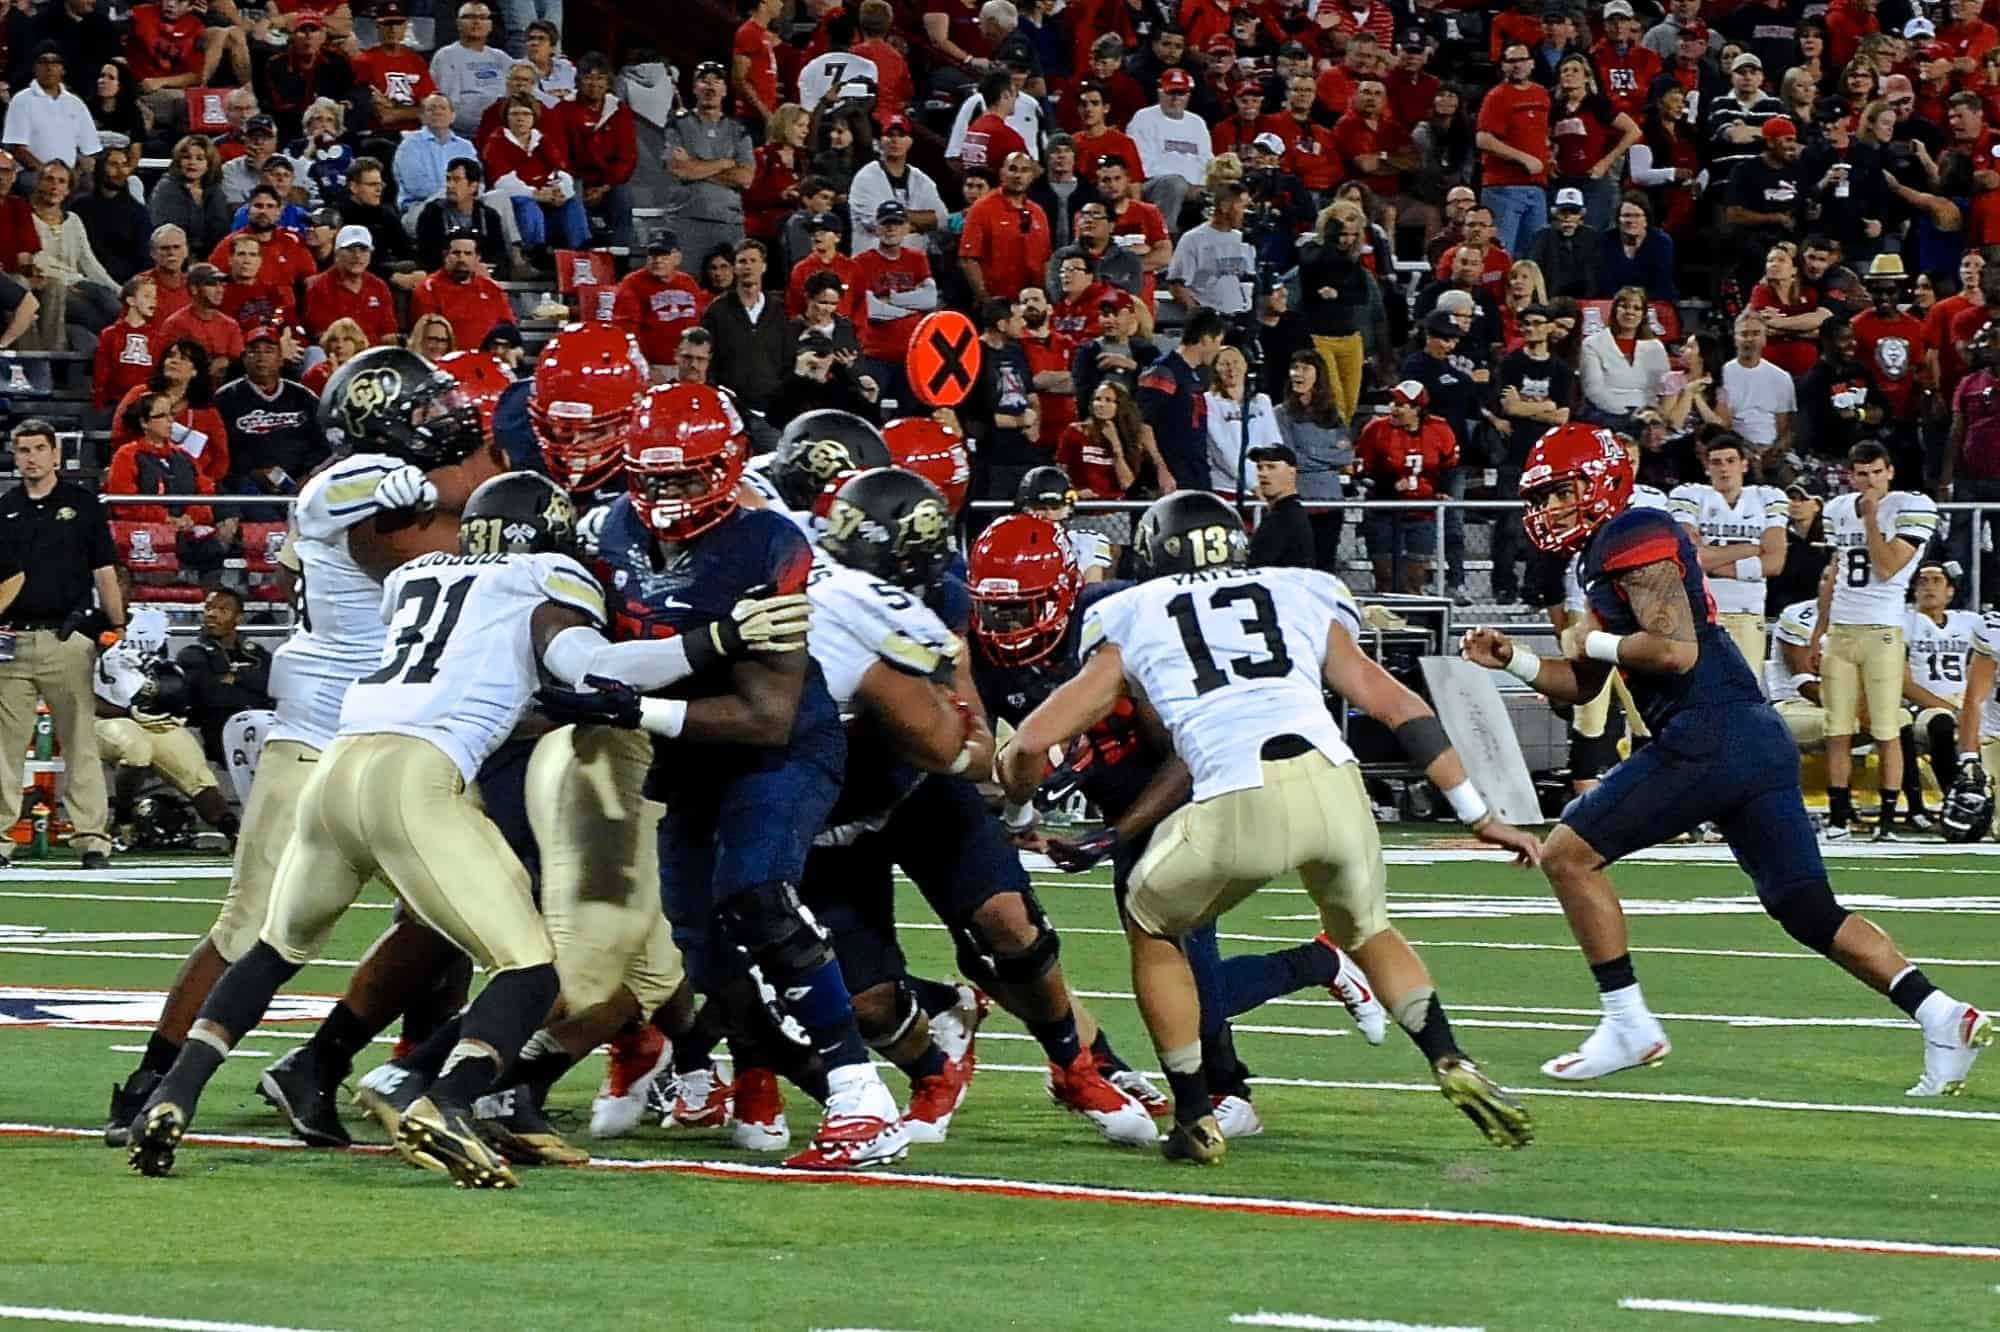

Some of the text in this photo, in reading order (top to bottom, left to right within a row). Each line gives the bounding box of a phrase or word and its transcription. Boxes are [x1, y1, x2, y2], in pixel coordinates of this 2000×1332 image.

[824, 63, 848, 84] 7
[119, 333, 152, 366] A
[9, 364, 33, 390] A
[1405, 454, 1423, 490] 7
[469, 518, 503, 555] 31
[1187, 525, 1229, 567] 13
[1699, 523, 1762, 540] COLORADO
[1847, 548, 1872, 588] 8
[358, 575, 478, 684] 31
[1167, 582, 1294, 697] 13
[1927, 654, 1962, 682] 15
